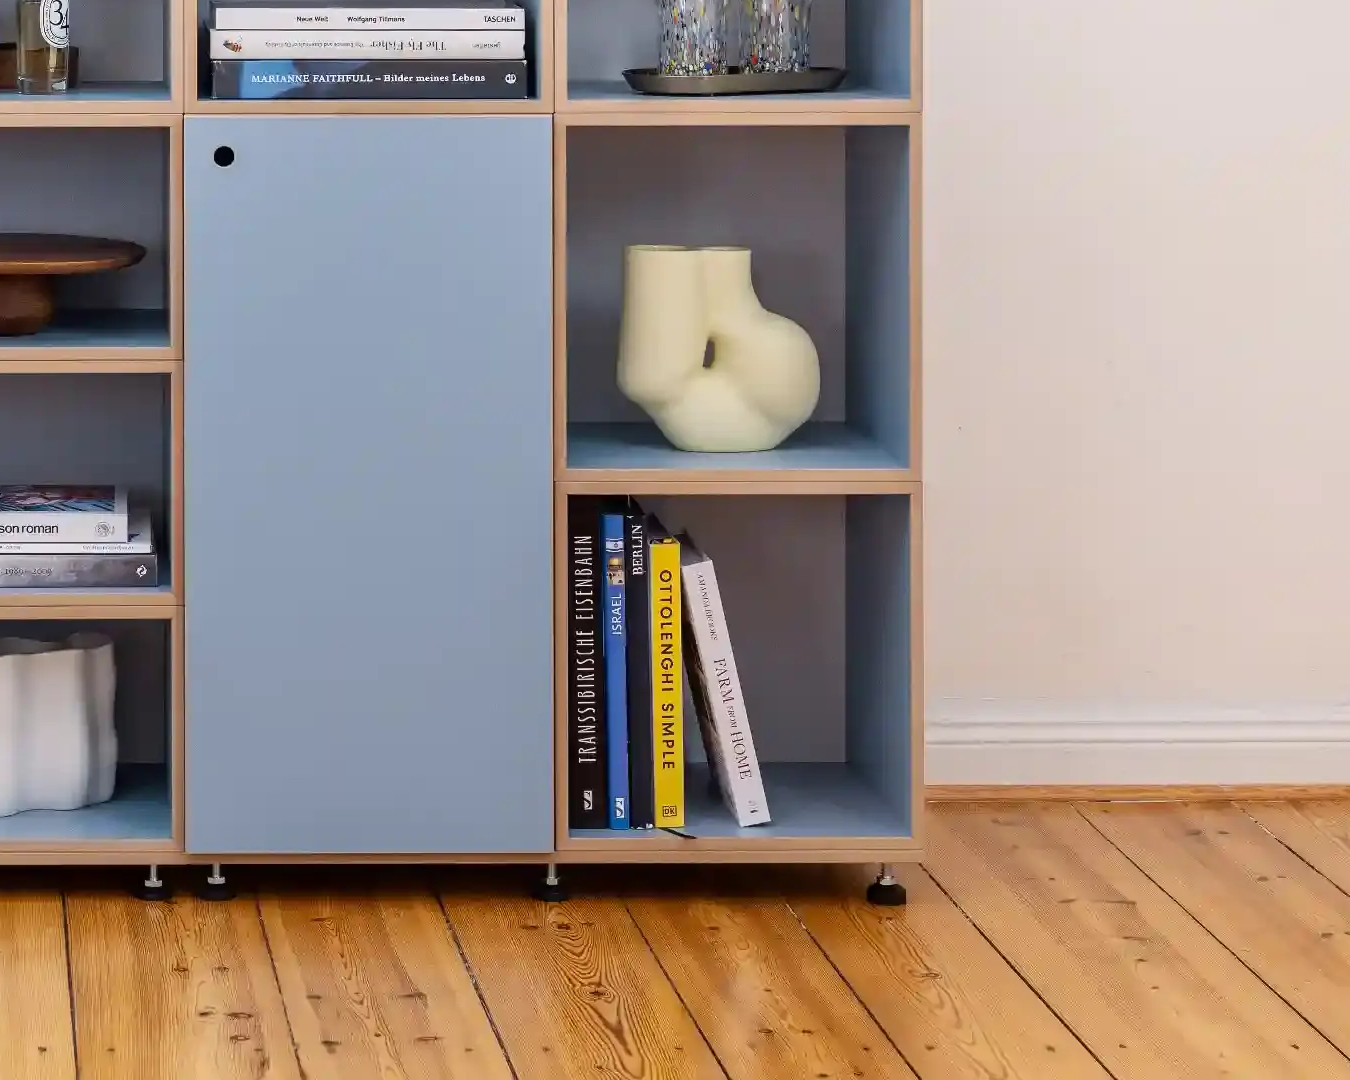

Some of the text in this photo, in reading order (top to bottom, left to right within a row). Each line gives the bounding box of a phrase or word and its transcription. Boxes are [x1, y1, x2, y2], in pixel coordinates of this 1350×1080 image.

[347, 16, 377, 24] Wolfgang
[483, 15, 516, 23] TASCHEN
[369, 37, 447, 51] The Fly Fisher
[251, 74, 310, 84] MARIANNE
[313, 74, 373, 83] FAITHFULL
[383, 73, 414, 83] Bilder
[415, 73, 449, 83] meines
[452, 73, 486, 83] Lebens
[21, 525, 59, 534] roman
[632, 523, 644, 576] BERLIN
[573, 534, 595, 622] EISENBAHN
[611, 593, 622, 636] ISRAEL
[696, 573, 719, 642] AMANDA BROOKS
[659, 569, 675, 770] OTTOLENGHI SIMPLE
[713, 658, 734, 704] FARM
[574, 628, 597, 764] TRANSSIBIRISCHE
[726, 705, 738, 729] FROM
[729, 731, 753, 781] HOME
[664, 807, 676, 816] DK
